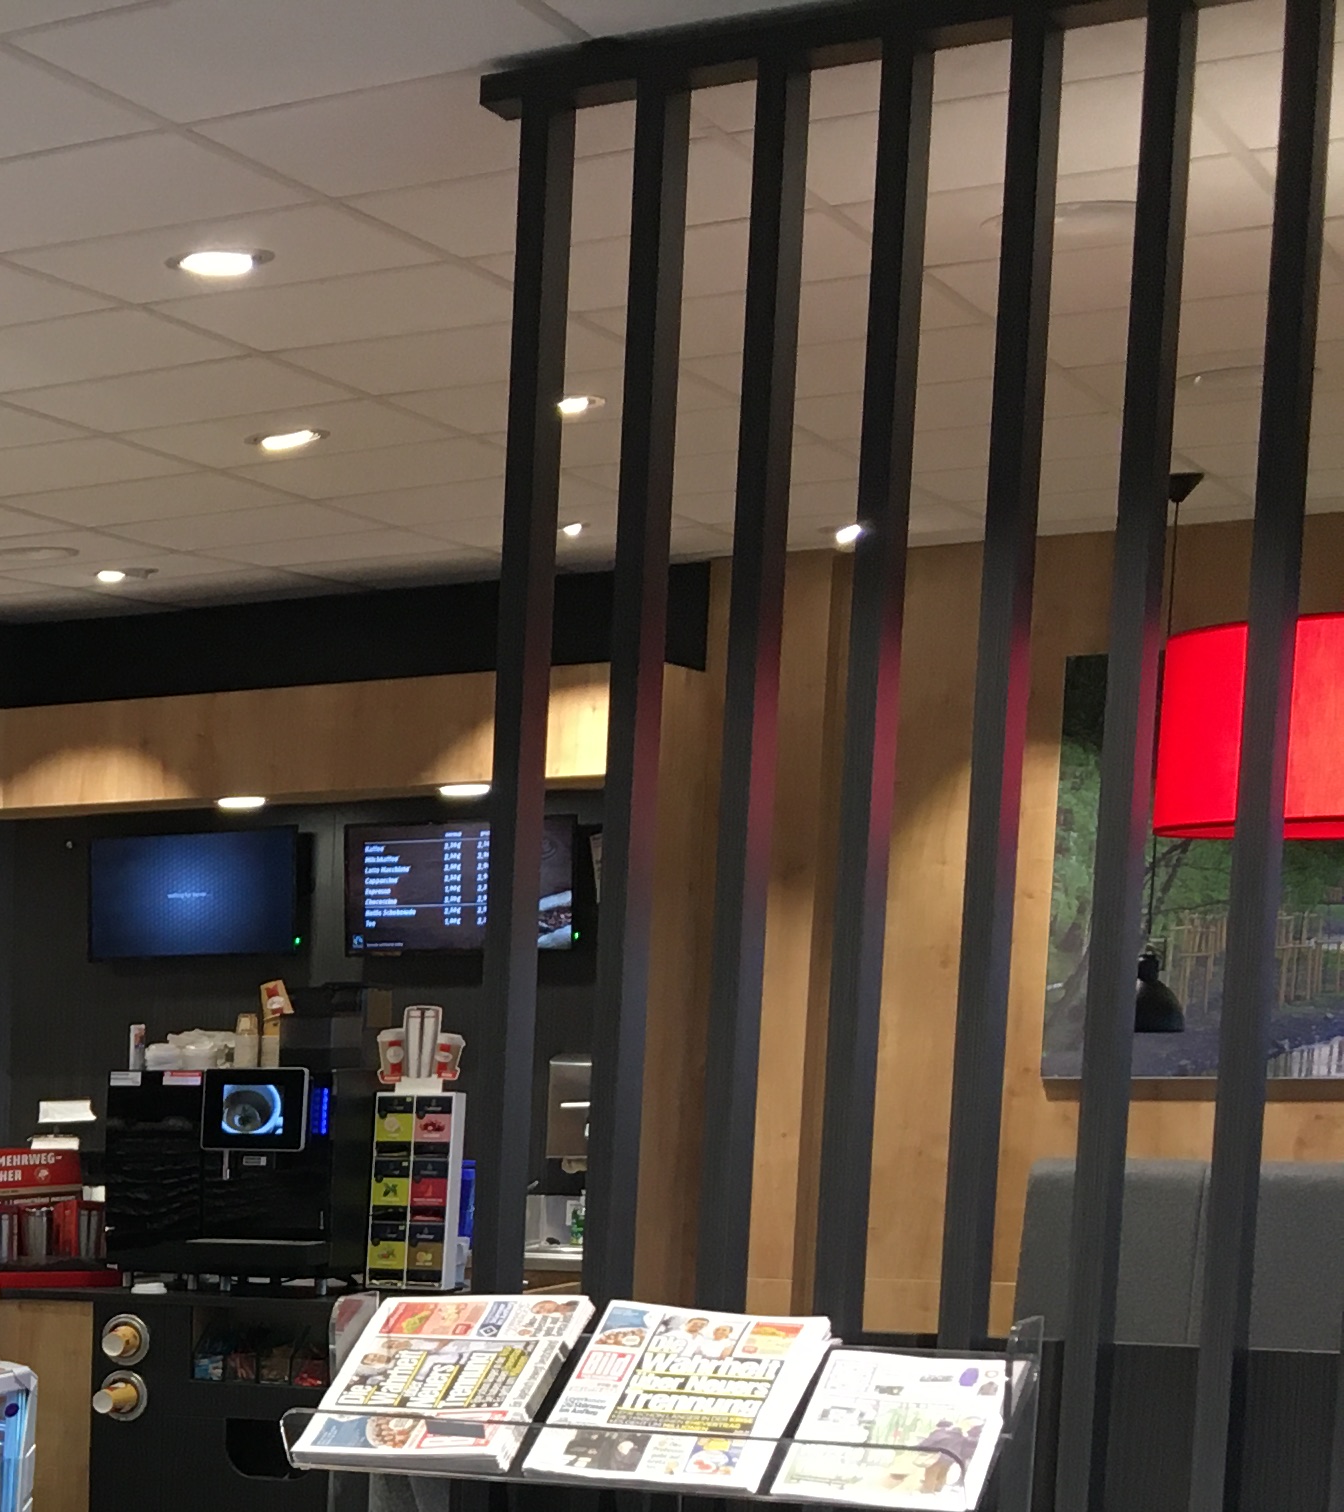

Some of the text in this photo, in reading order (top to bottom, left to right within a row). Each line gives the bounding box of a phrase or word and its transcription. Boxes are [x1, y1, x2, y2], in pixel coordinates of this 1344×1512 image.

[369, 1350, 426, 1406] Wahrheit
[440, 1351, 496, 1408] Trennung
[580, 1350, 633, 1377] Bild
[642, 1351, 784, 1381] Wahrheit
[406, 1363, 456, 1408] Neuers
[624, 1391, 763, 1418] Trennung
